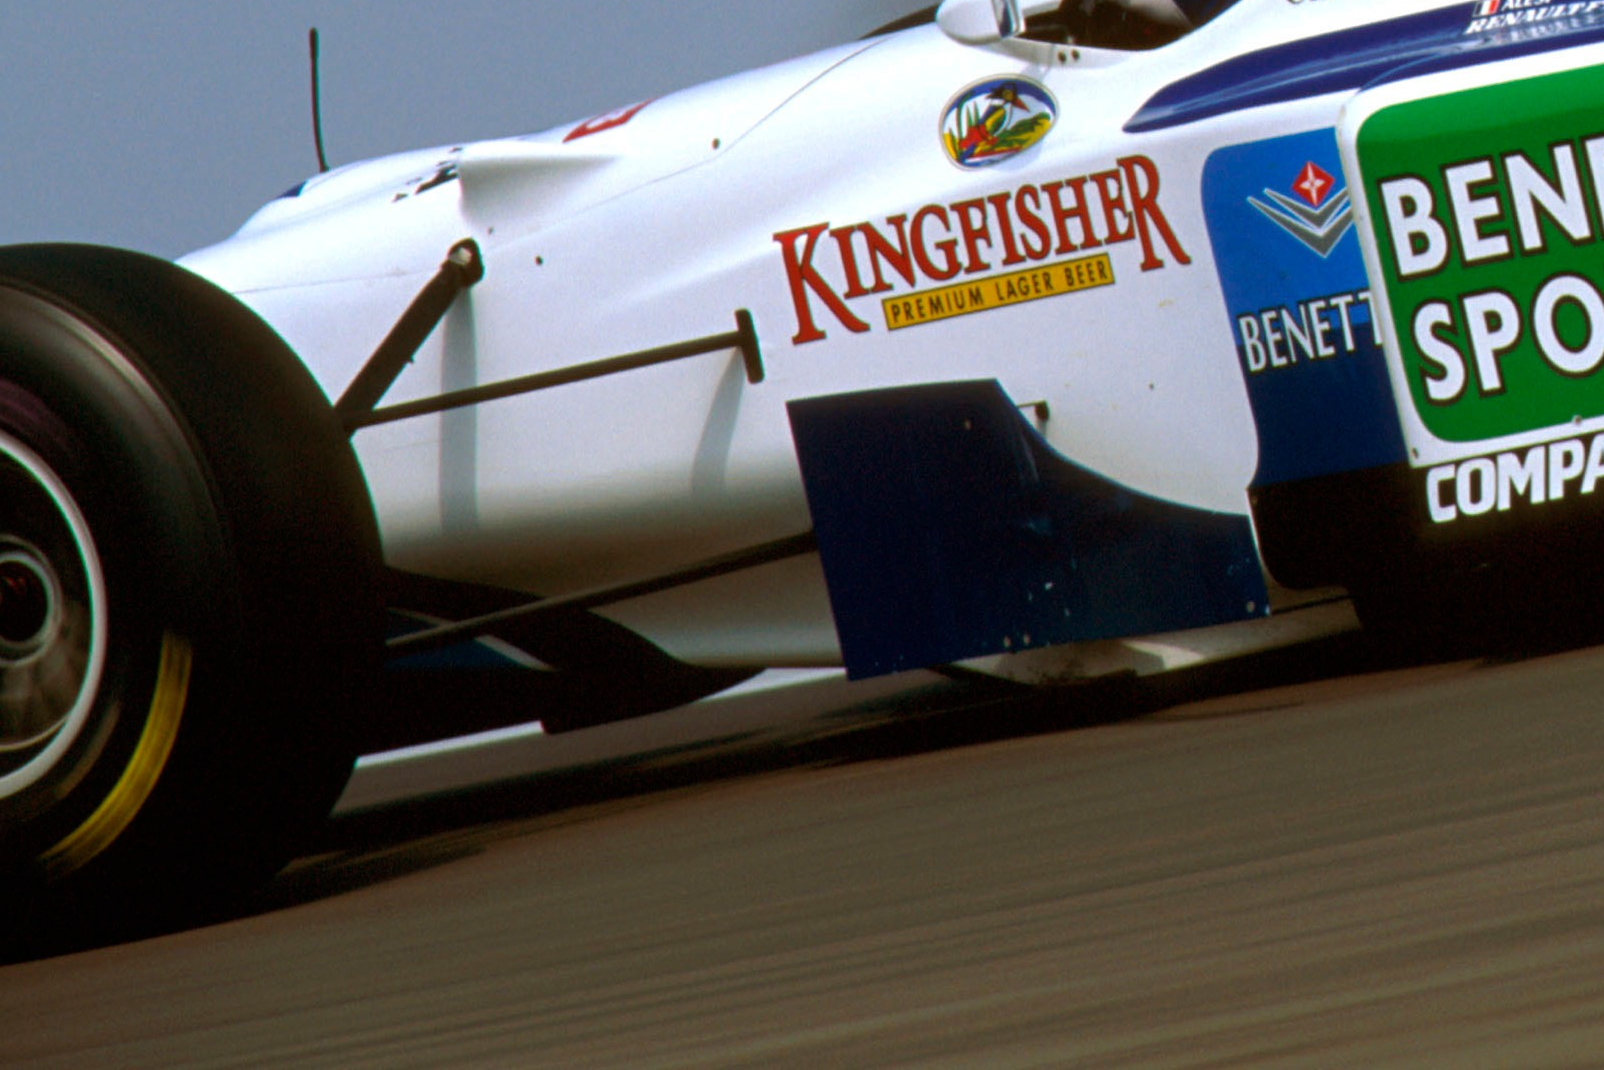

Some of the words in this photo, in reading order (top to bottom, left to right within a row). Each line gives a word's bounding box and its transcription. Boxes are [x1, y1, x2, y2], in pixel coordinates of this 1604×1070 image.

[1465, 1, 1586, 34] RENAULT
[773, 155, 1191, 345] KINGFISHER
[891, 287, 984, 323] PREMIUM
[996, 272, 1054, 302] LAGER
[1064, 260, 1108, 288] BEER
